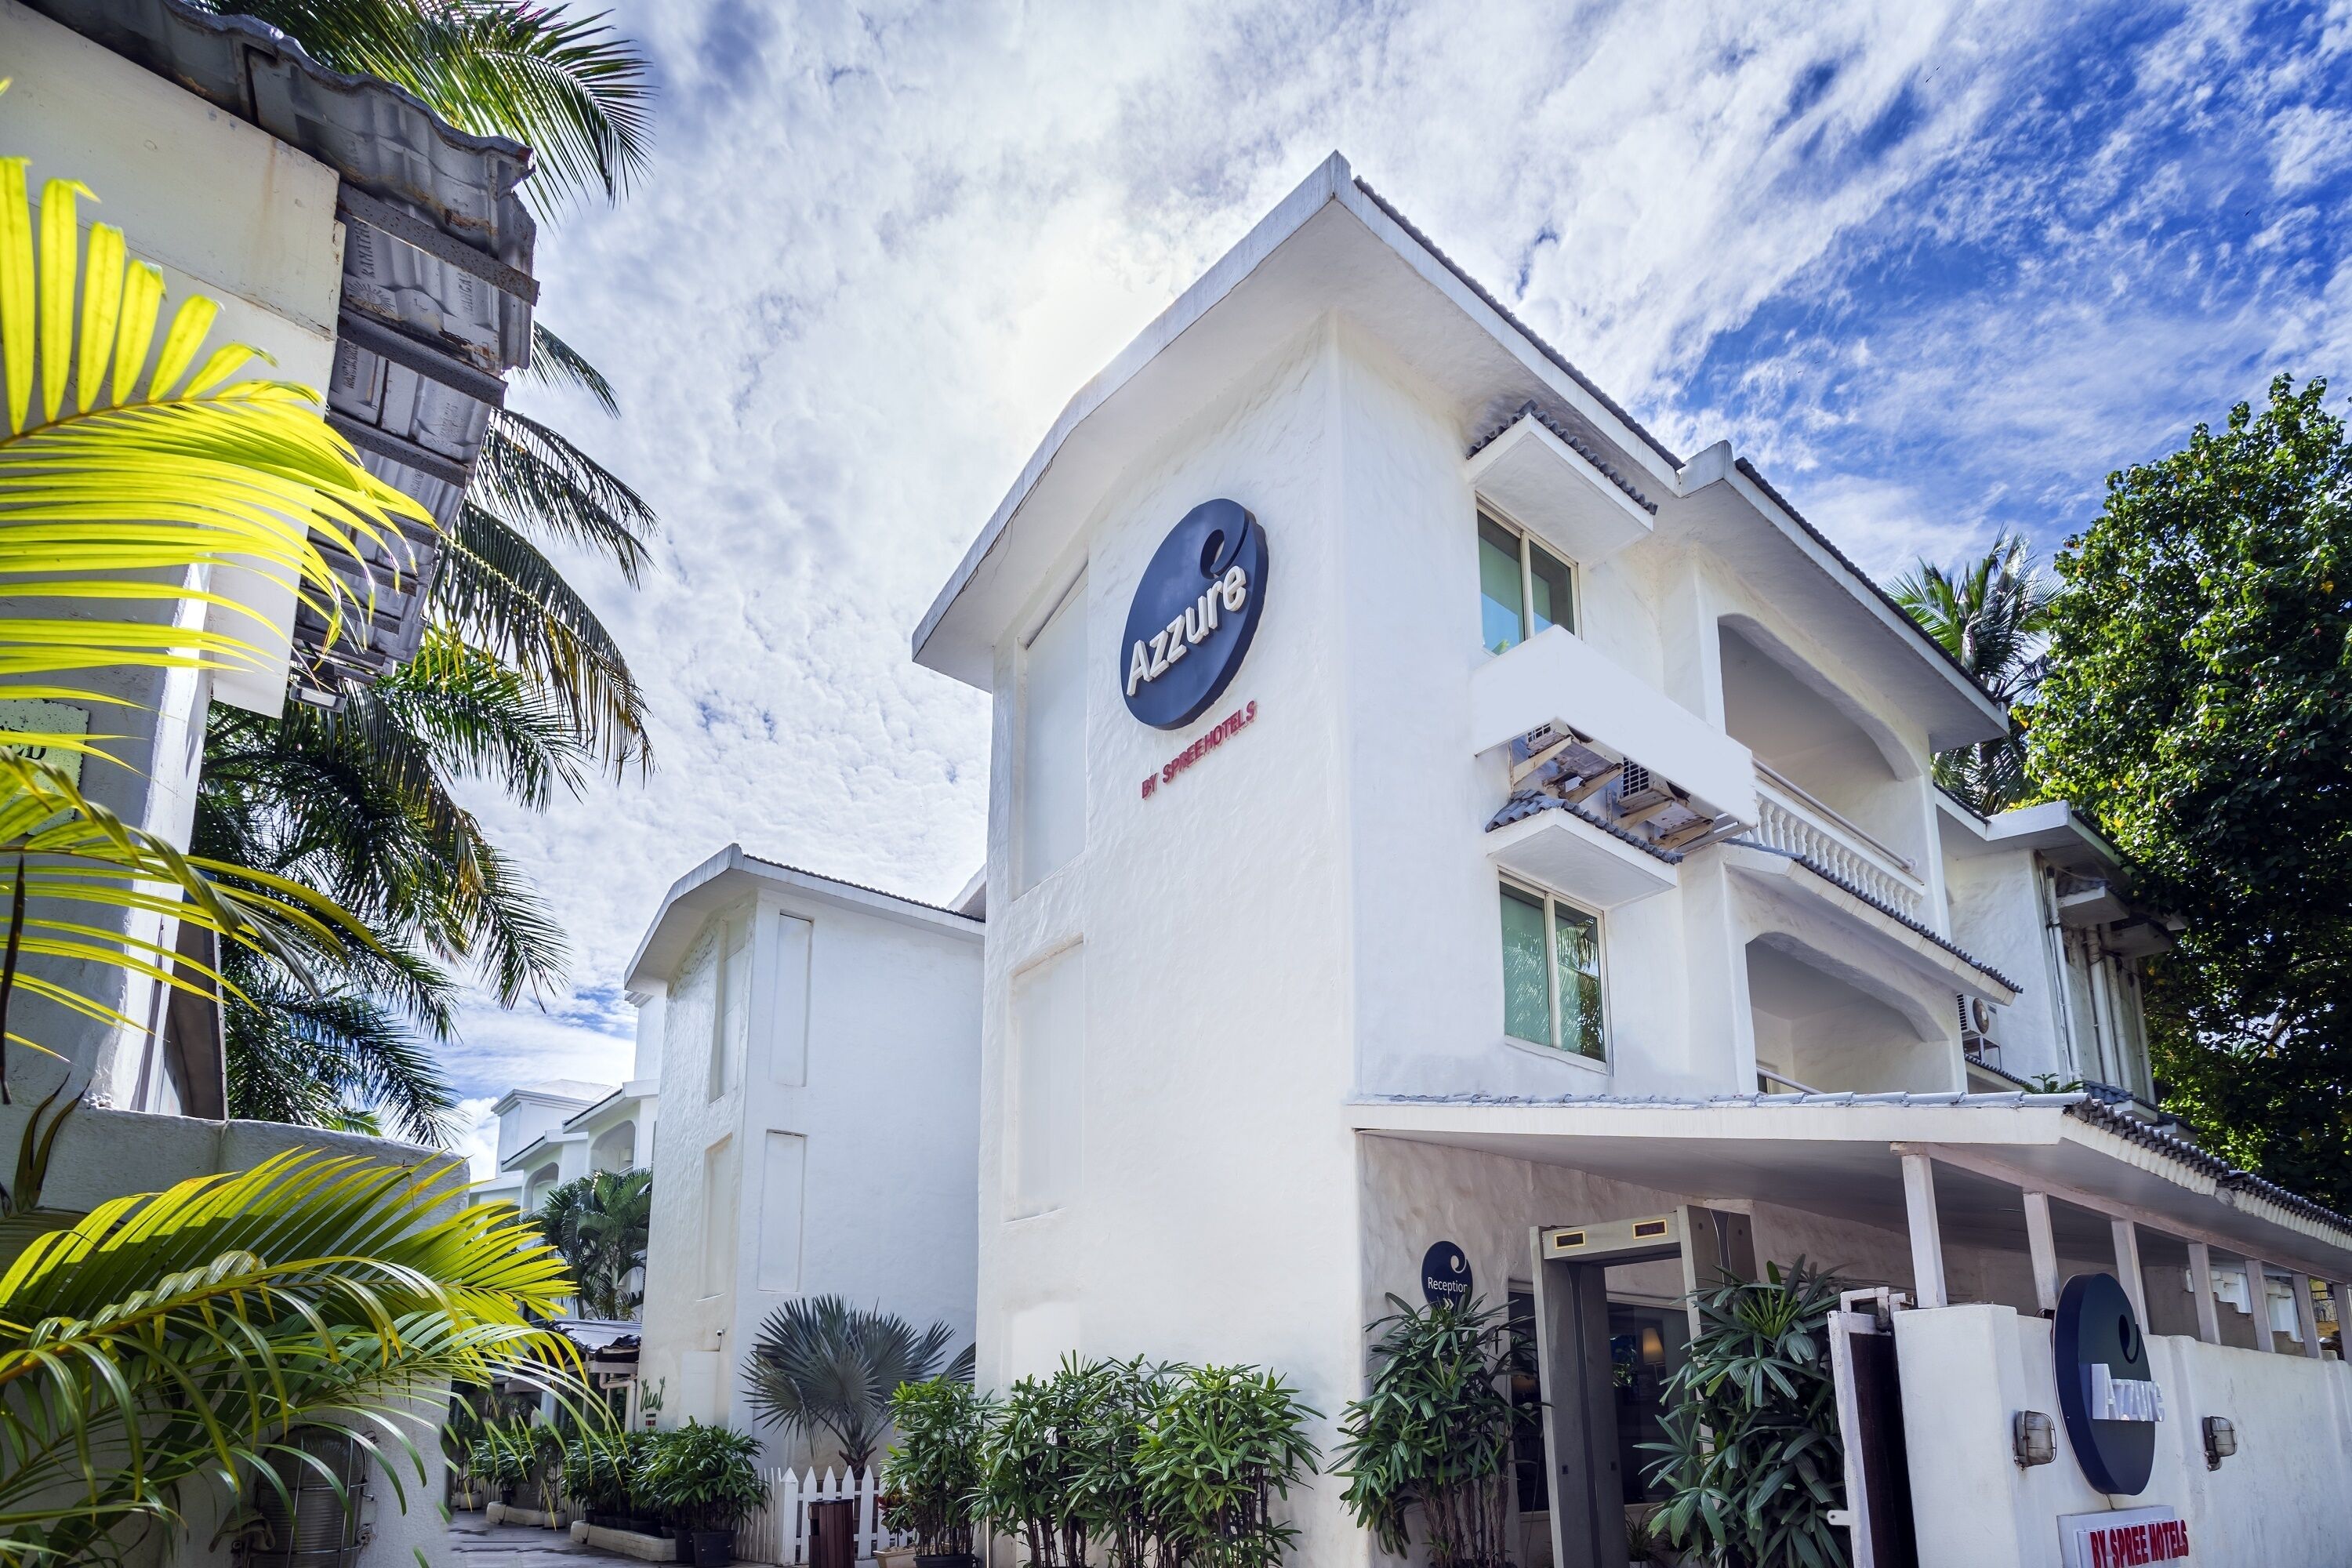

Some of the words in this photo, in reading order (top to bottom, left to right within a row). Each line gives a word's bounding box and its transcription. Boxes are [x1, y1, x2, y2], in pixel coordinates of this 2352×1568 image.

[1127, 564, 1247, 697] Azzure
[1142, 772, 1160, 800] BY
[1162, 738, 1205, 784] SPREE
[1204, 700, 1257, 755] HOTELS
[2089, 1530, 2108, 1568] BY
[2109, 1525, 2149, 1568] SPREE
[2148, 1519, 2189, 1562] HOTELS
